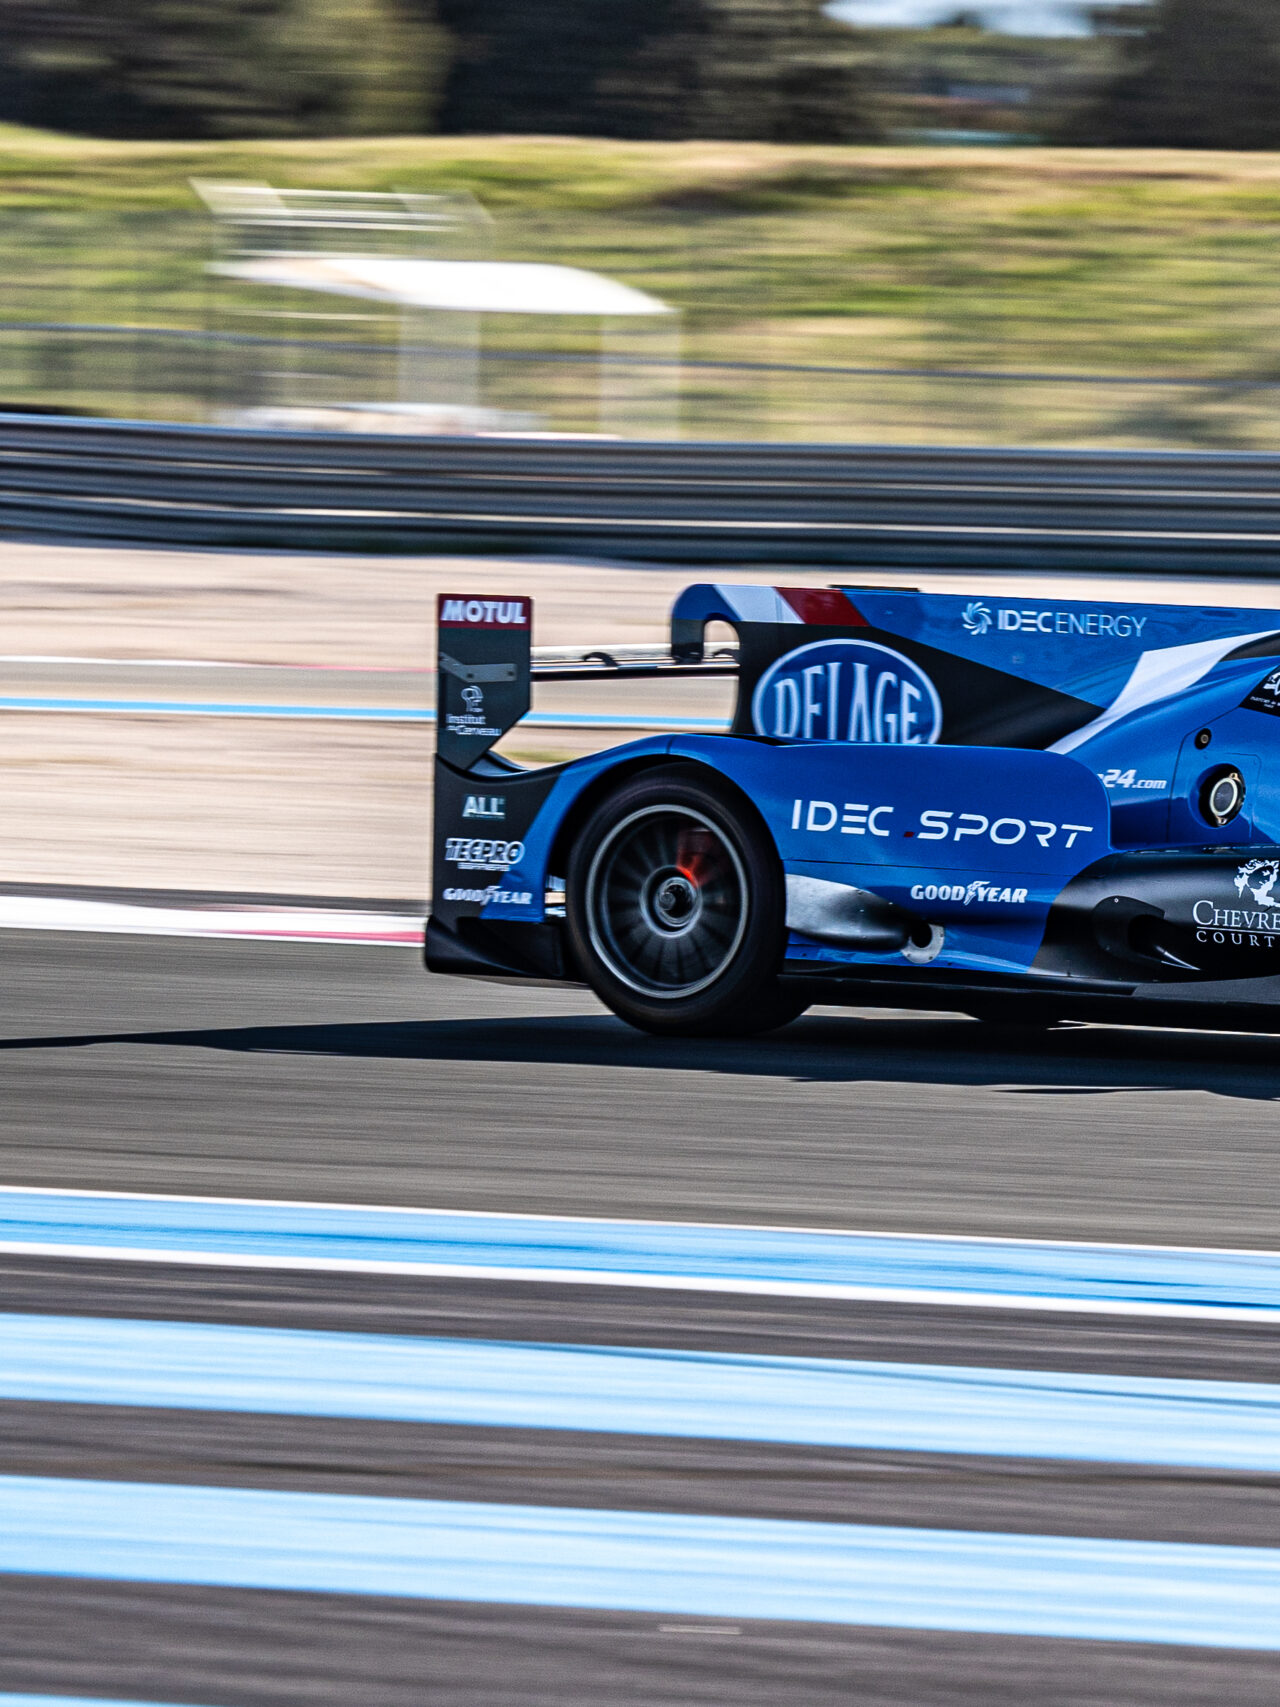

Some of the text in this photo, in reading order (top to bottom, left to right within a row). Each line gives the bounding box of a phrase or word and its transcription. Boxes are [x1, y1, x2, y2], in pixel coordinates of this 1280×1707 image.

[441, 600, 527, 624] MOTUL
[791, 800, 893, 837] IDEC
[445, 837, 525, 865] TECPRO
[911, 881, 1028, 905] GOODYEAR
